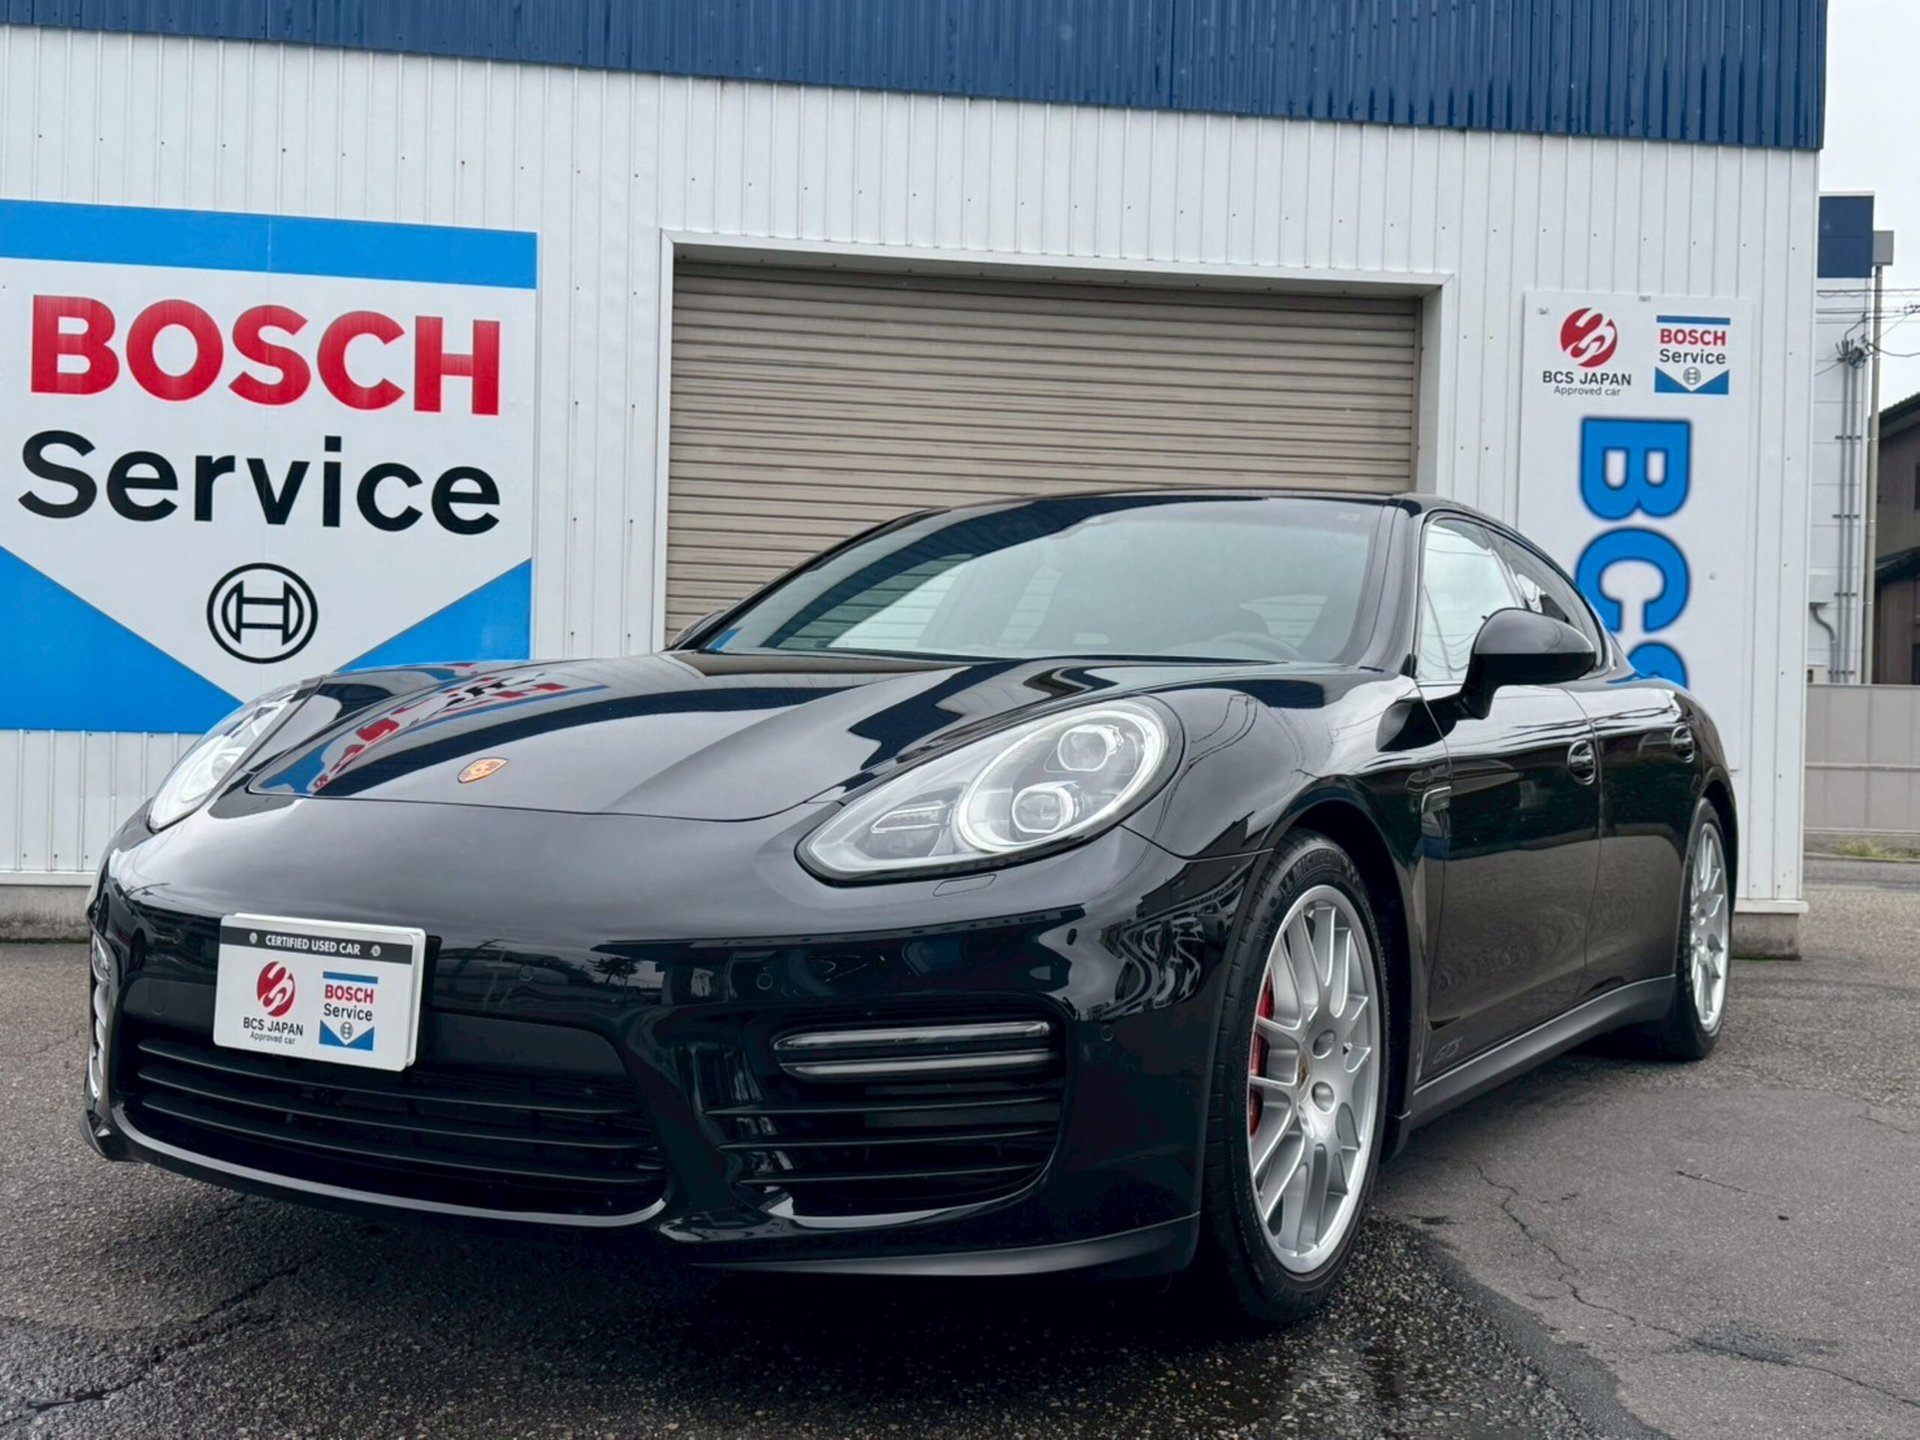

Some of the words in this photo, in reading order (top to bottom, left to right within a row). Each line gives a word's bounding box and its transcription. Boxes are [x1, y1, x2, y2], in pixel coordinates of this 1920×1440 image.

[1659, 328, 1726, 346] BOSCH
[31, 294, 500, 416] BOSCH
[1659, 348, 1726, 365] Service
[1542, 370, 1574, 384] BCS
[1579, 372, 1632, 386] JAPAN
[1553, 385, 1602, 397] Approved
[1605, 388, 1621, 396] car
[18, 430, 500, 535] Service
[265, 934, 309, 949] CERTIFIED
[311, 939, 337, 953] USED
[339, 942, 361, 956] CAR
[324, 984, 374, 1004] BOSCH
[323, 1003, 373, 1021] Service
[243, 1017, 265, 1031] BCS
[267, 1020, 304, 1037] JAPAN
[249, 1031, 283, 1044] Approved
[284, 1037, 296, 1045] car
